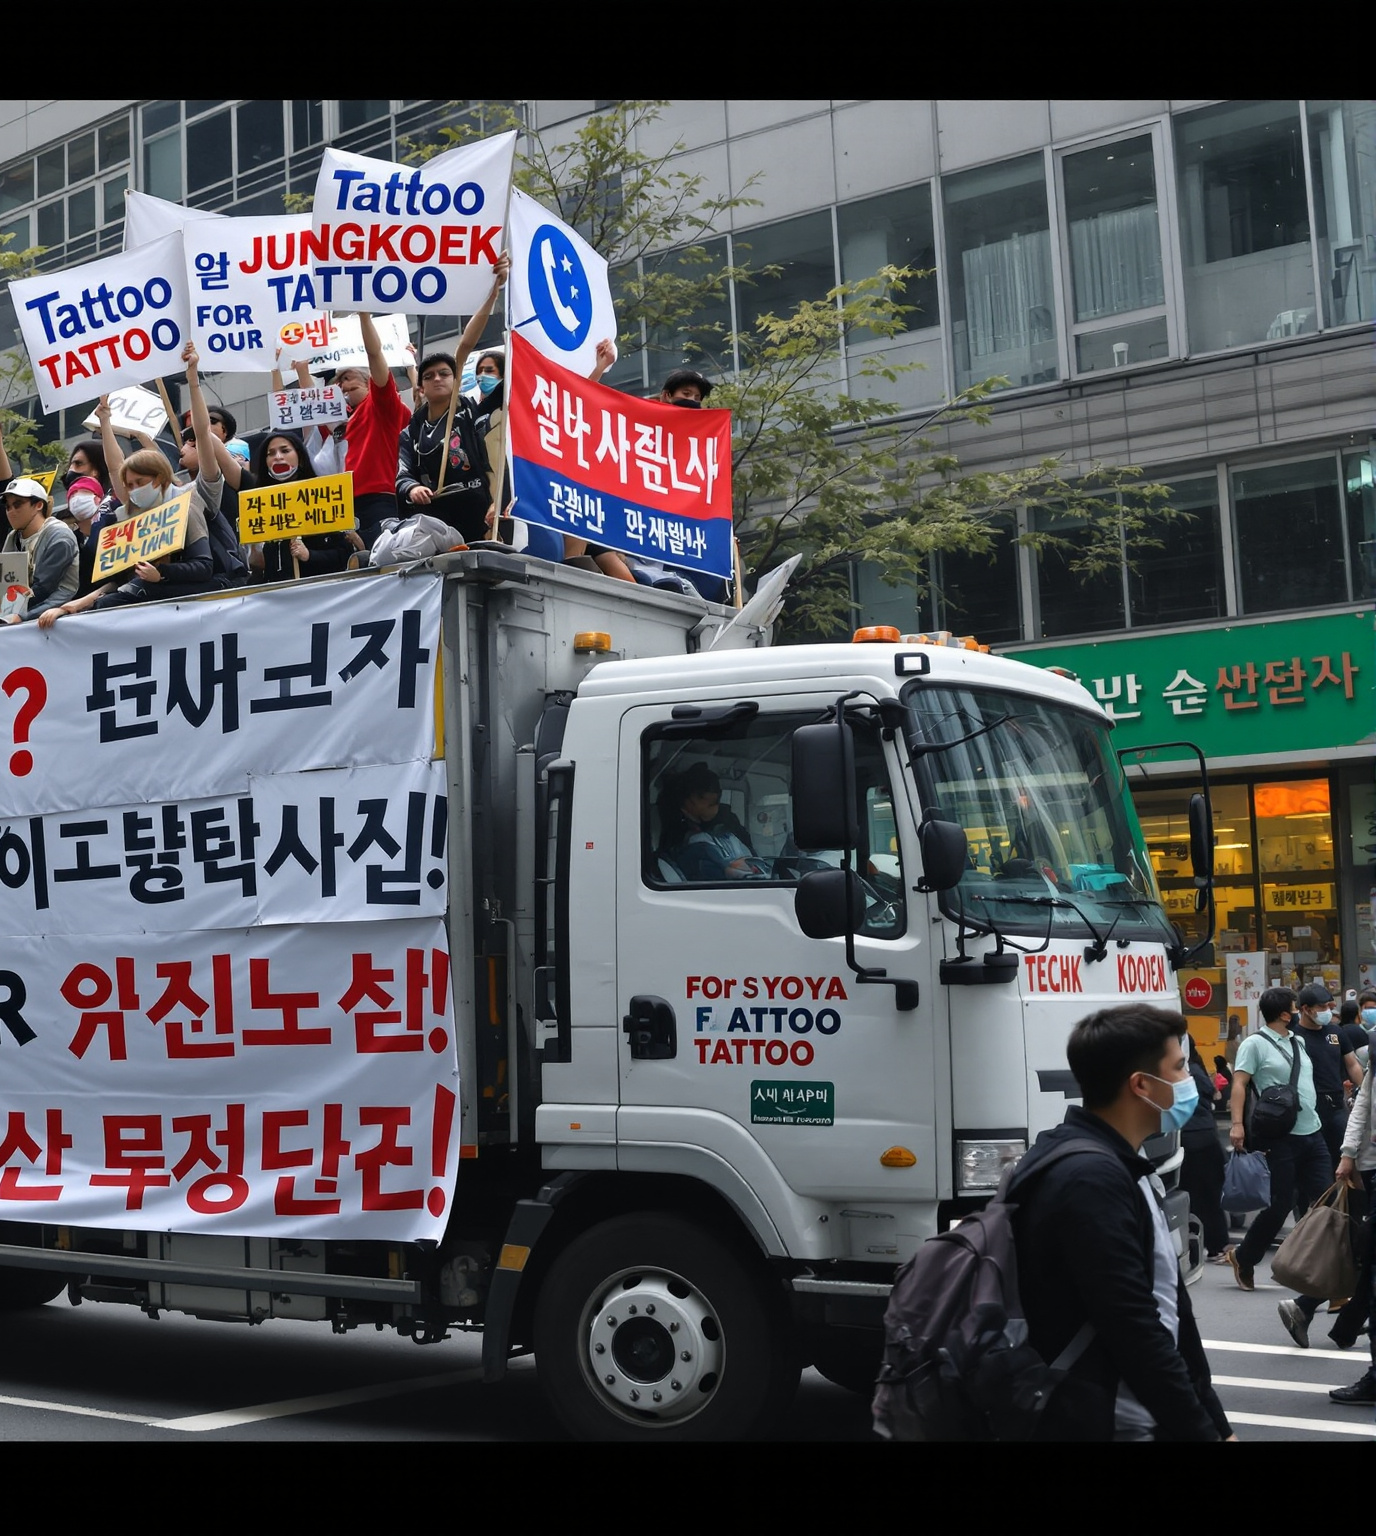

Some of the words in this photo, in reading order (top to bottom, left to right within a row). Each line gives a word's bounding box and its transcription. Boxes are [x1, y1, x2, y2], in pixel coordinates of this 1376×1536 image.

[333, 170, 485, 216] Tattoo
[239, 222, 503, 274] JUNGKOEK
[267, 265, 448, 313] TATTOO
[25, 277, 172, 345] Tattoo
[197, 304, 254, 327] FOR
[38, 318, 181, 389] TATTOO
[208, 329, 264, 353] OUR
[1025, 954, 1083, 993] TECHK
[727, 1007, 842, 1035] ATTOO
[694, 1039, 815, 1067] TATTOO
